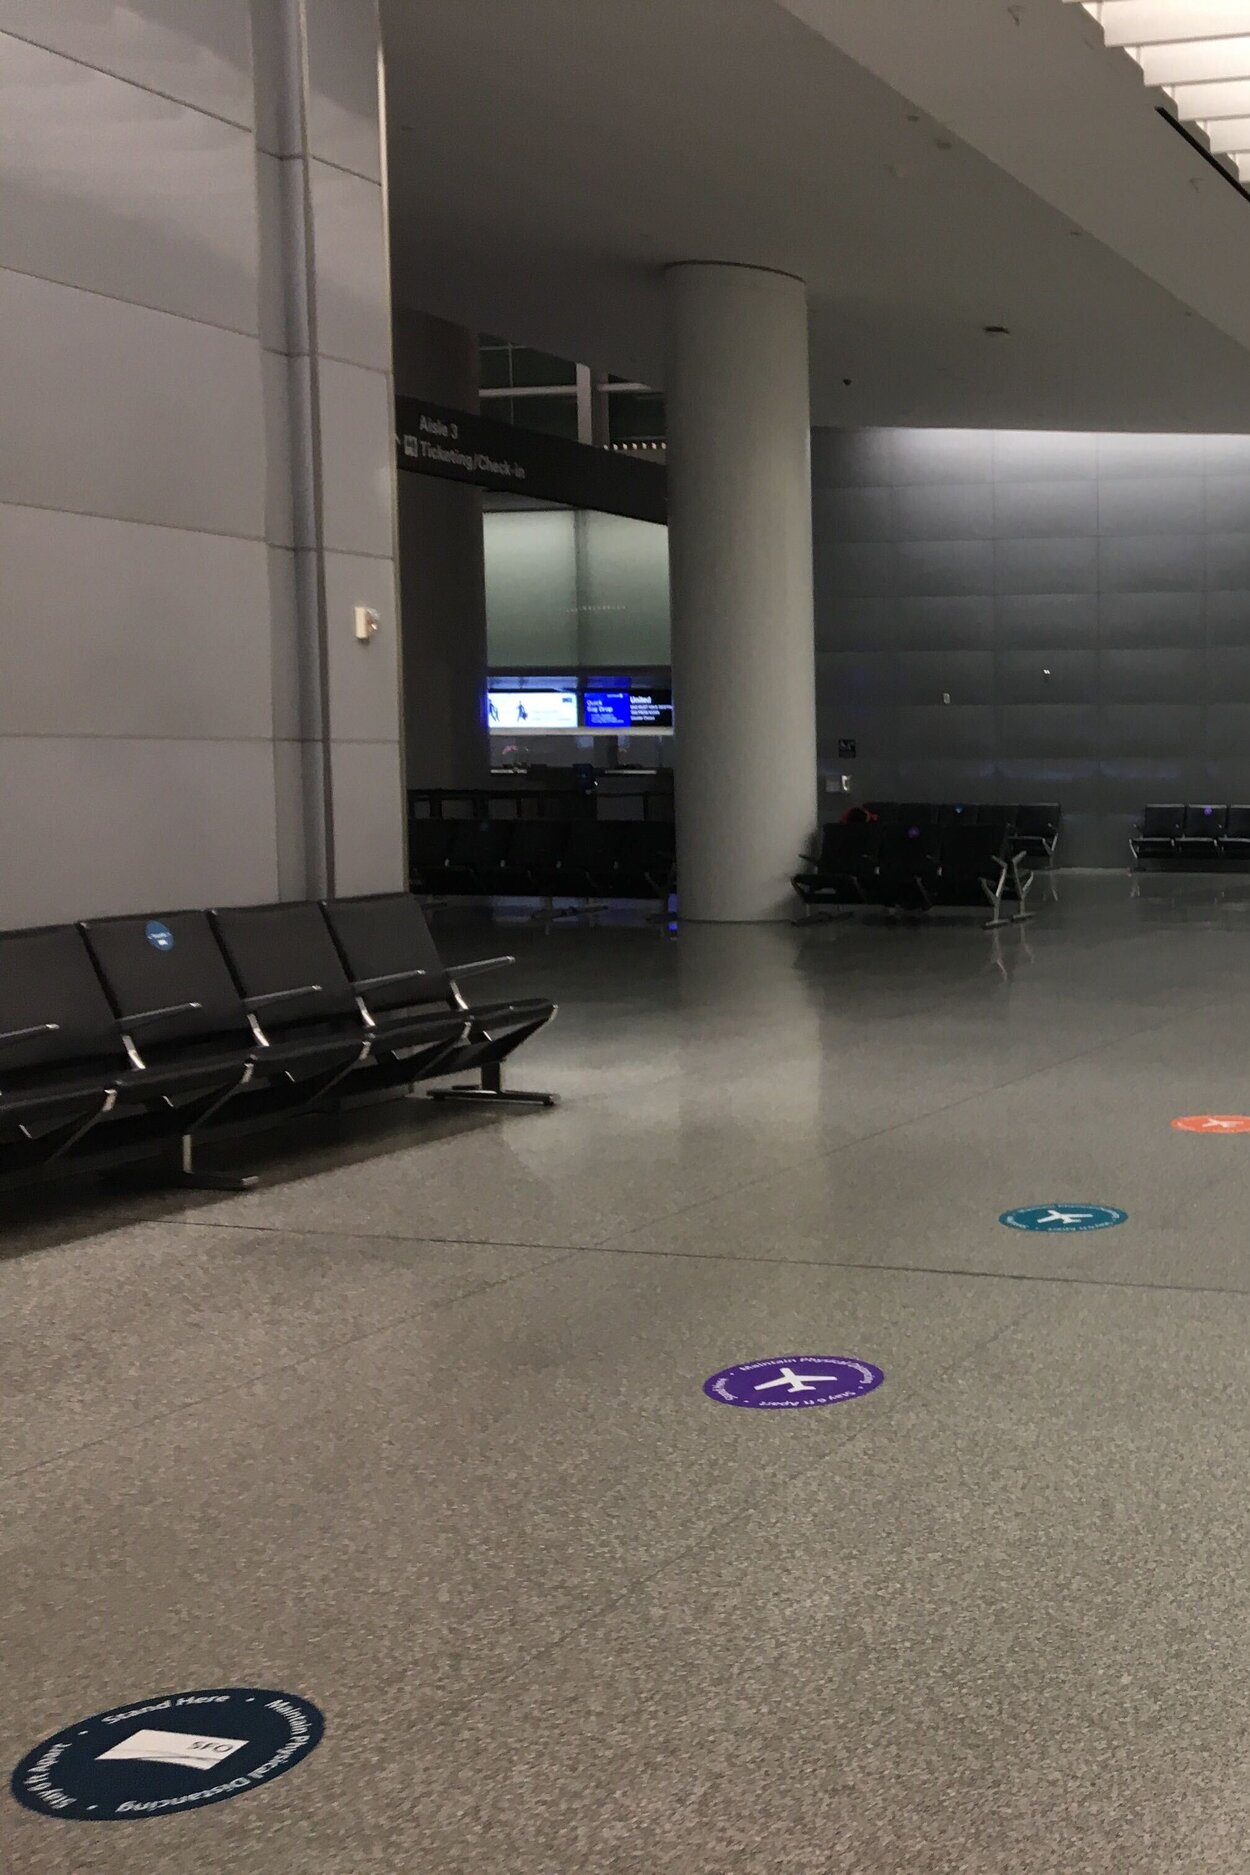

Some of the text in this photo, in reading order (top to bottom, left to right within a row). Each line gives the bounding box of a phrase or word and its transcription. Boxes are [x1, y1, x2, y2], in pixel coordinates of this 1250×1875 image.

[419, 415, 448, 437] Aisle
[101, 1695, 231, 1725] Stand Here
[27, 1742, 72, 1773] Apart
[115, 1699, 313, 1813] Maintain Physical Distancing
[186, 1741, 234, 1754] SFO
[36, 1788, 78, 1810] Stay
